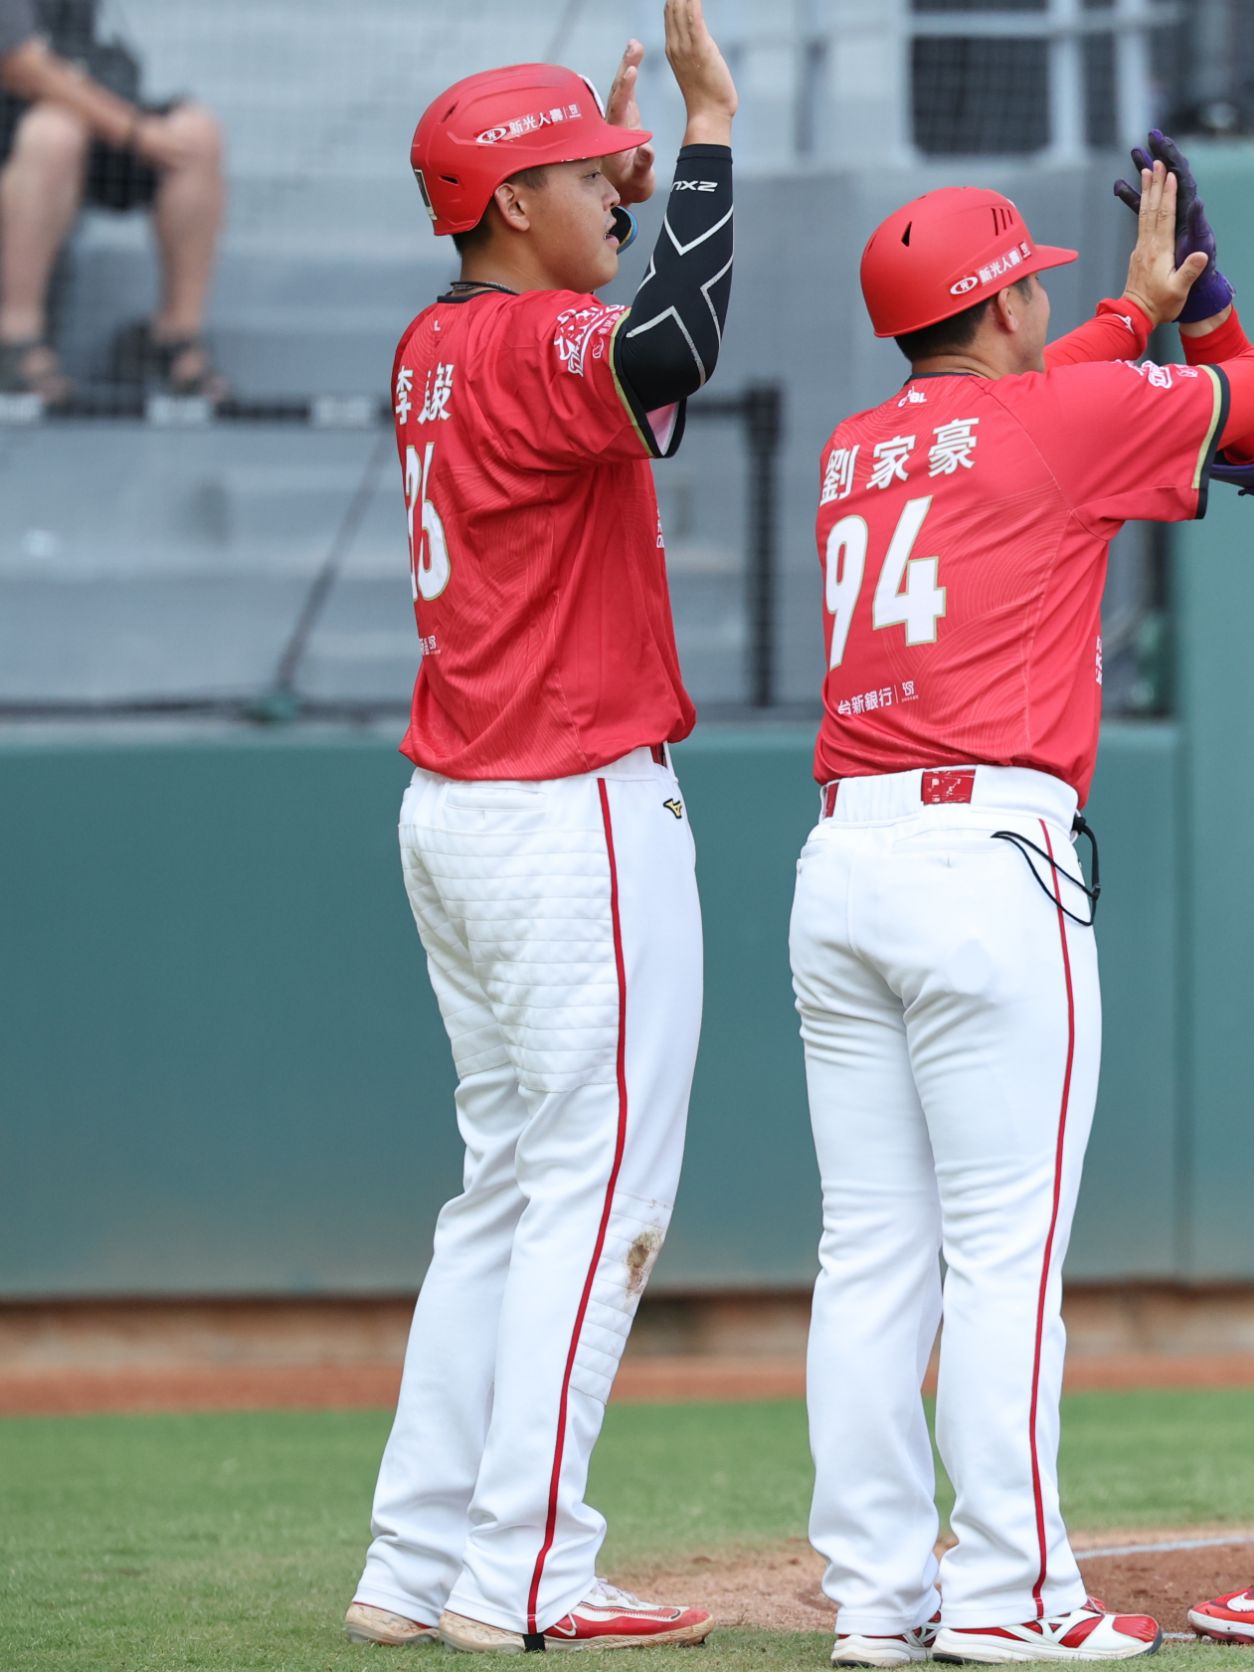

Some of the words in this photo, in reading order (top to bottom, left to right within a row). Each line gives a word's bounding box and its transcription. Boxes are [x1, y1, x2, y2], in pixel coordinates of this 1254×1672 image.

[819, 417, 980, 507] 劉家豪
[825, 494, 946, 672] 94
[838, 687, 893, 715] 台新銀行
